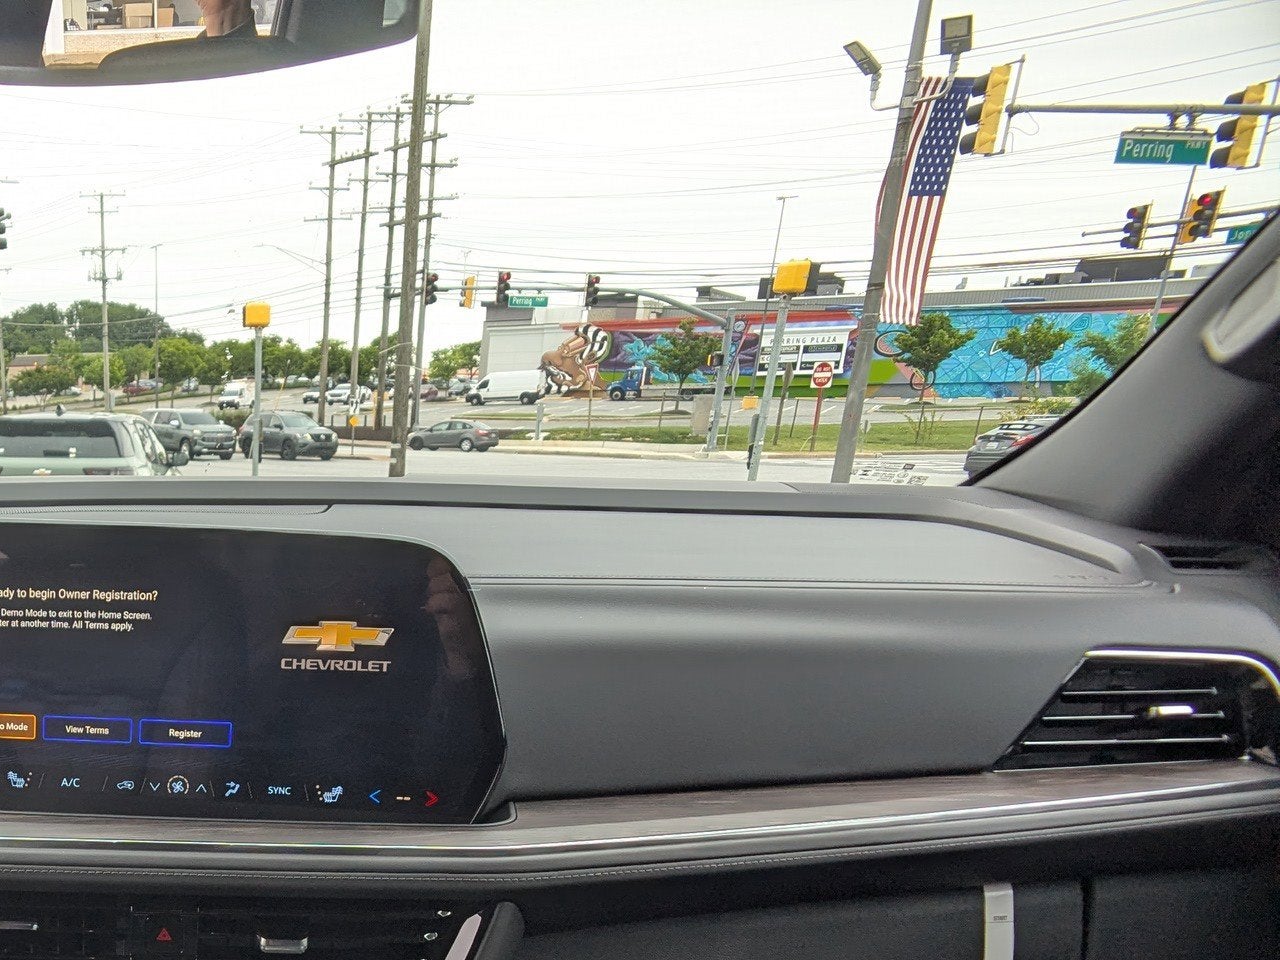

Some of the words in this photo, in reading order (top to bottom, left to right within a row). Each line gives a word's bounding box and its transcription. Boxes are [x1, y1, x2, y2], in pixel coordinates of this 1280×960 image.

[1122, 140, 1174, 162] Perring
[1185, 141, 1207, 149] PKWY
[1231, 230, 1256, 240] Jop
[512, 297, 532, 307] Perring
[17, 588, 27, 598] to
[29, 588, 56, 601] begin
[58, 589, 91, 599] Owner
[93, 589, 158, 602] Registration?
[1, 608, 24, 617] Demo
[25, 608, 48, 618] Mode
[49, 609, 57, 618] to
[58, 610, 73, 618] exit
[74, 610, 82, 618] to
[83, 610, 96, 619] the
[98, 610, 122, 619] Home
[123, 610, 153, 620] Screen.
[10, 619, 19, 627] at
[20, 619, 50, 628] another
[51, 620, 71, 629] time.
[72, 620, 83, 629] All
[84, 621, 110, 630] Terms
[111, 622, 135, 632] apply.
[280, 658, 391, 672] CHEVROLET
[6, 722, 29, 732] Mode
[65, 725, 84, 734] View
[85, 725, 110, 735] Terms
[169, 728, 202, 740] Register
[61, 777, 81, 788] A/C
[267, 785, 292, 796] SYNC
